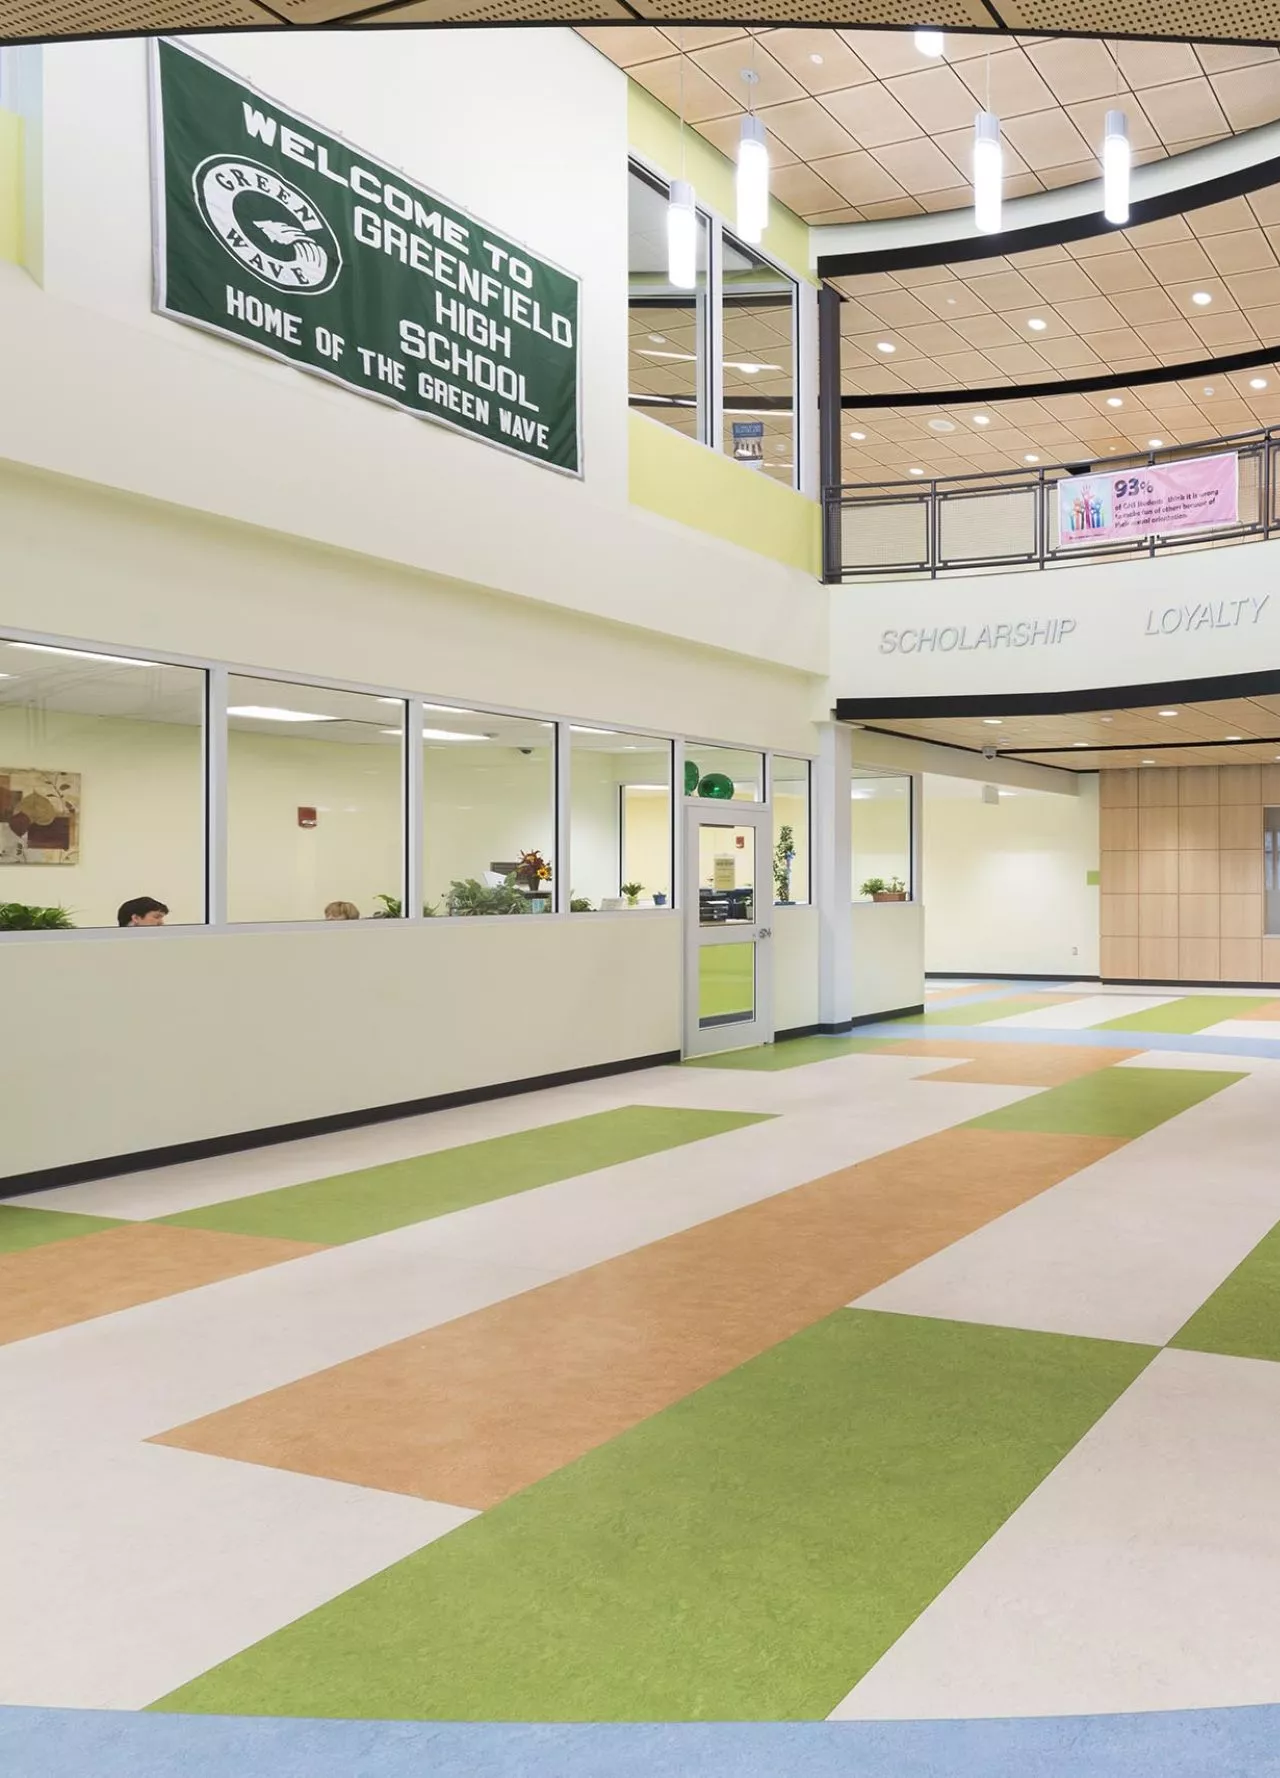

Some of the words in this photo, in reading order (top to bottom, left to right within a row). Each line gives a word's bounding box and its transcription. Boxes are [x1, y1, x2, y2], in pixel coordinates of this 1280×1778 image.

[215, 168, 316, 222] GREEN
[242, 102, 470, 256] WELCOME
[483, 241, 534, 289] TO
[226, 228, 310, 285] WAVE
[354, 206, 573, 349] GREENFIELD
[436, 291, 511, 359] HIGH
[227, 285, 303, 346] HOME
[316, 327, 345, 362] OF
[358, 347, 406, 392] THE
[419, 373, 490, 426] GREEN
[499, 408, 550, 450] WAVE
[400, 320, 540, 413] SCHOOL
[1114, 478, 1154, 498] 93%
[879, 617, 1078, 655] SCHOLARSHIP
[1144, 593, 1270, 635] LOYALTY
